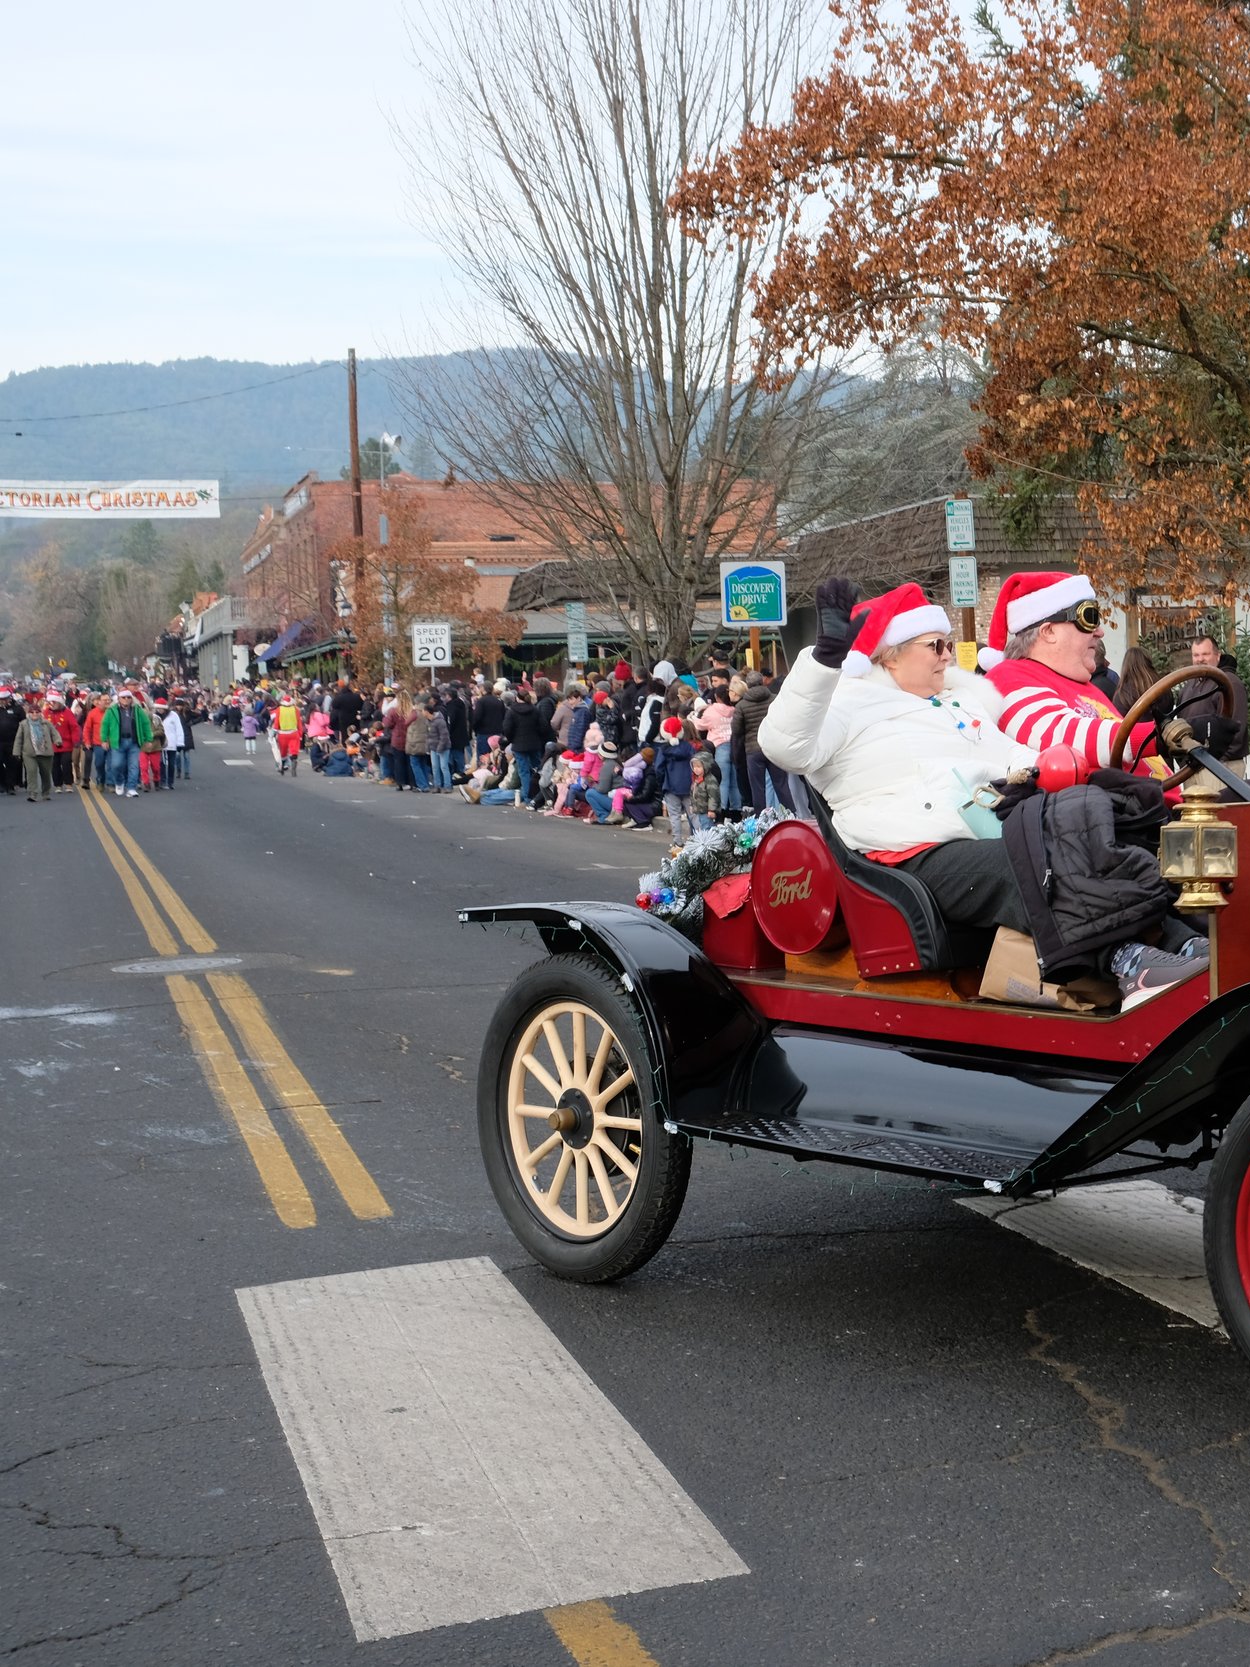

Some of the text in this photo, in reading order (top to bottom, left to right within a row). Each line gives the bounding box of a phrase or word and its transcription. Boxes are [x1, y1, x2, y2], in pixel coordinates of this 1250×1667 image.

[86, 490, 198, 511] CHRISTMAS
[731, 583, 775, 594] DISCOVERY
[741, 593, 768, 605] DRIVE
[416, 628, 447, 636] SPEED
[420, 637, 443, 645] LIMIT
[418, 646, 446, 662] 20
[768, 866, 813, 908] Ford
